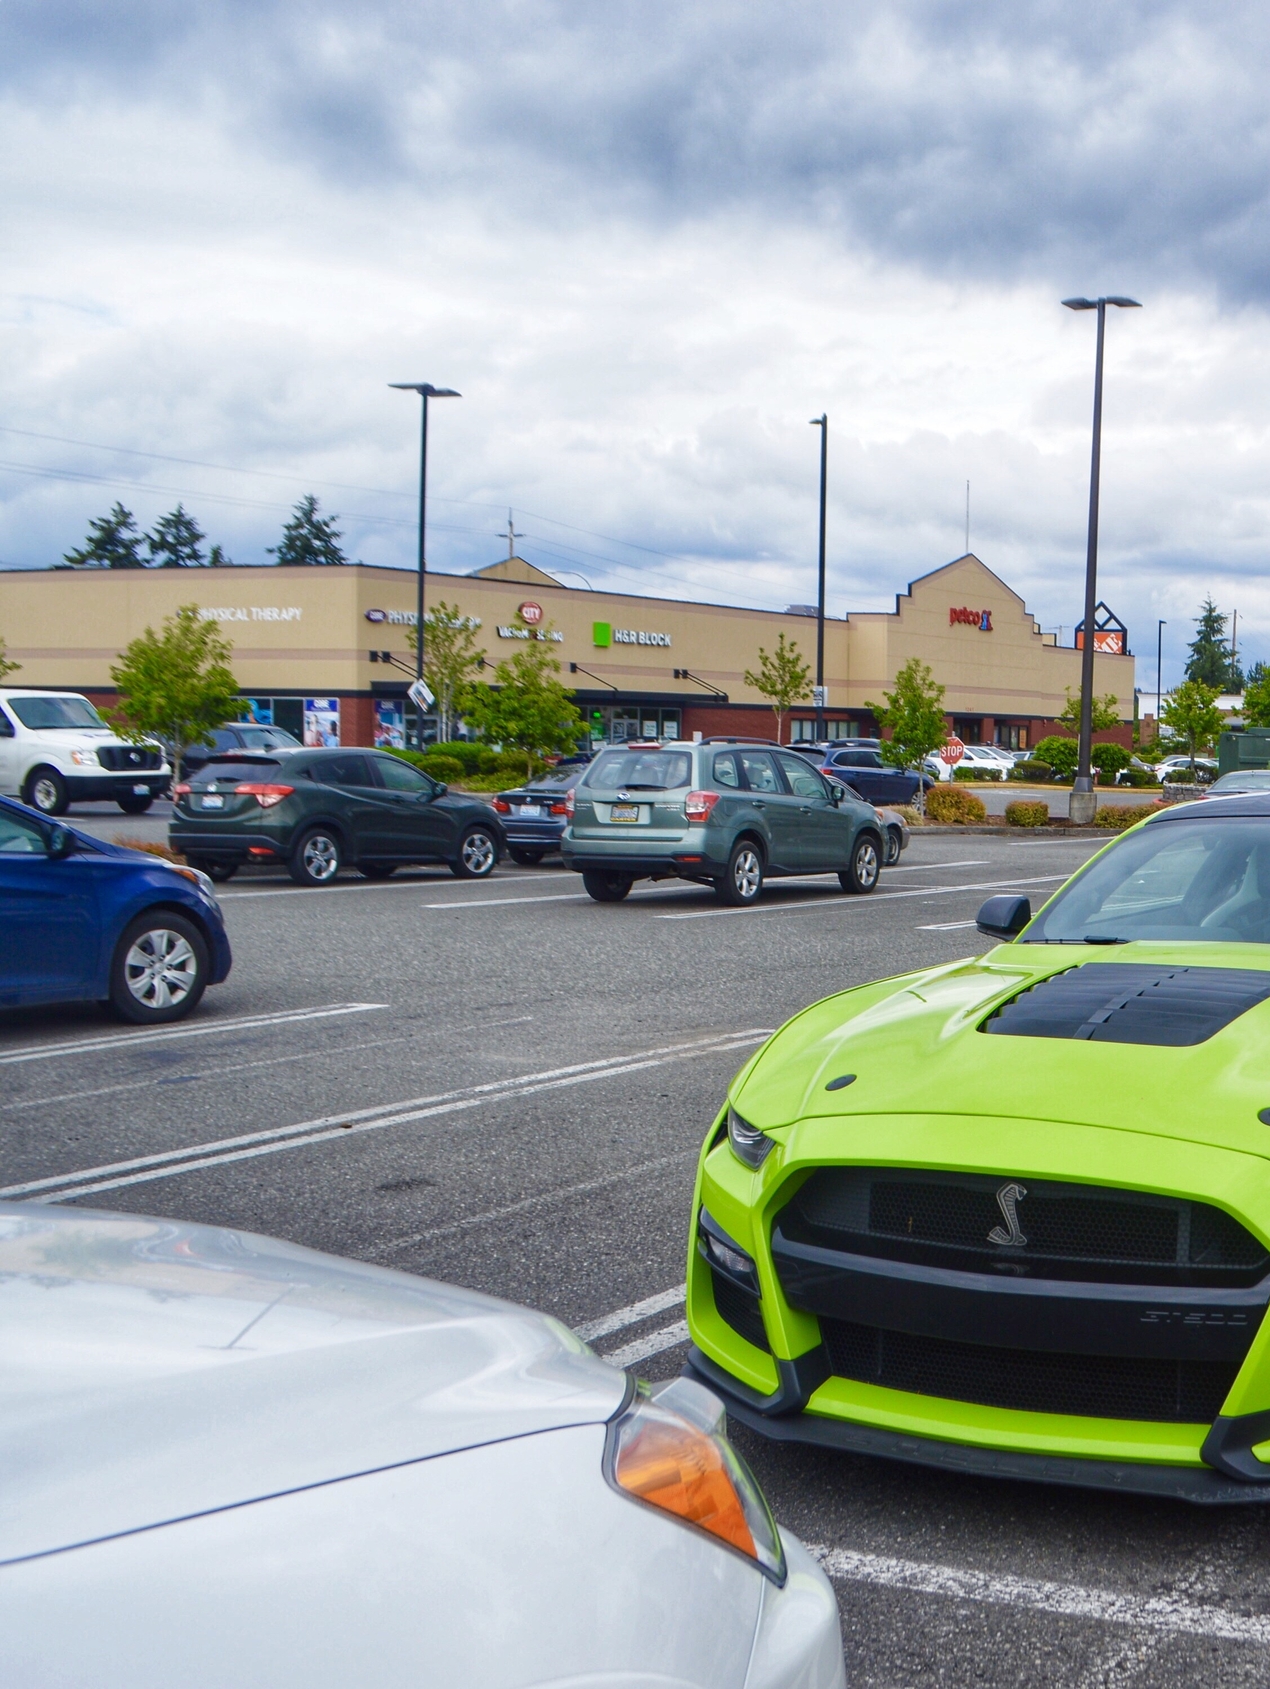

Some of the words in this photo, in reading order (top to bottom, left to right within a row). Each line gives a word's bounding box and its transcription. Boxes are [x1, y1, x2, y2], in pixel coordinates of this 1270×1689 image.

[250, 607, 302, 621] THERAPY
[522, 606, 542, 620] CITY
[949, 606, 980, 626] petco
[614, 629, 636, 643] H&R
[638, 632, 671, 646] BLOCK
[941, 745, 963, 757] STOP
[1139, 1310, 1249, 1327] GT500
